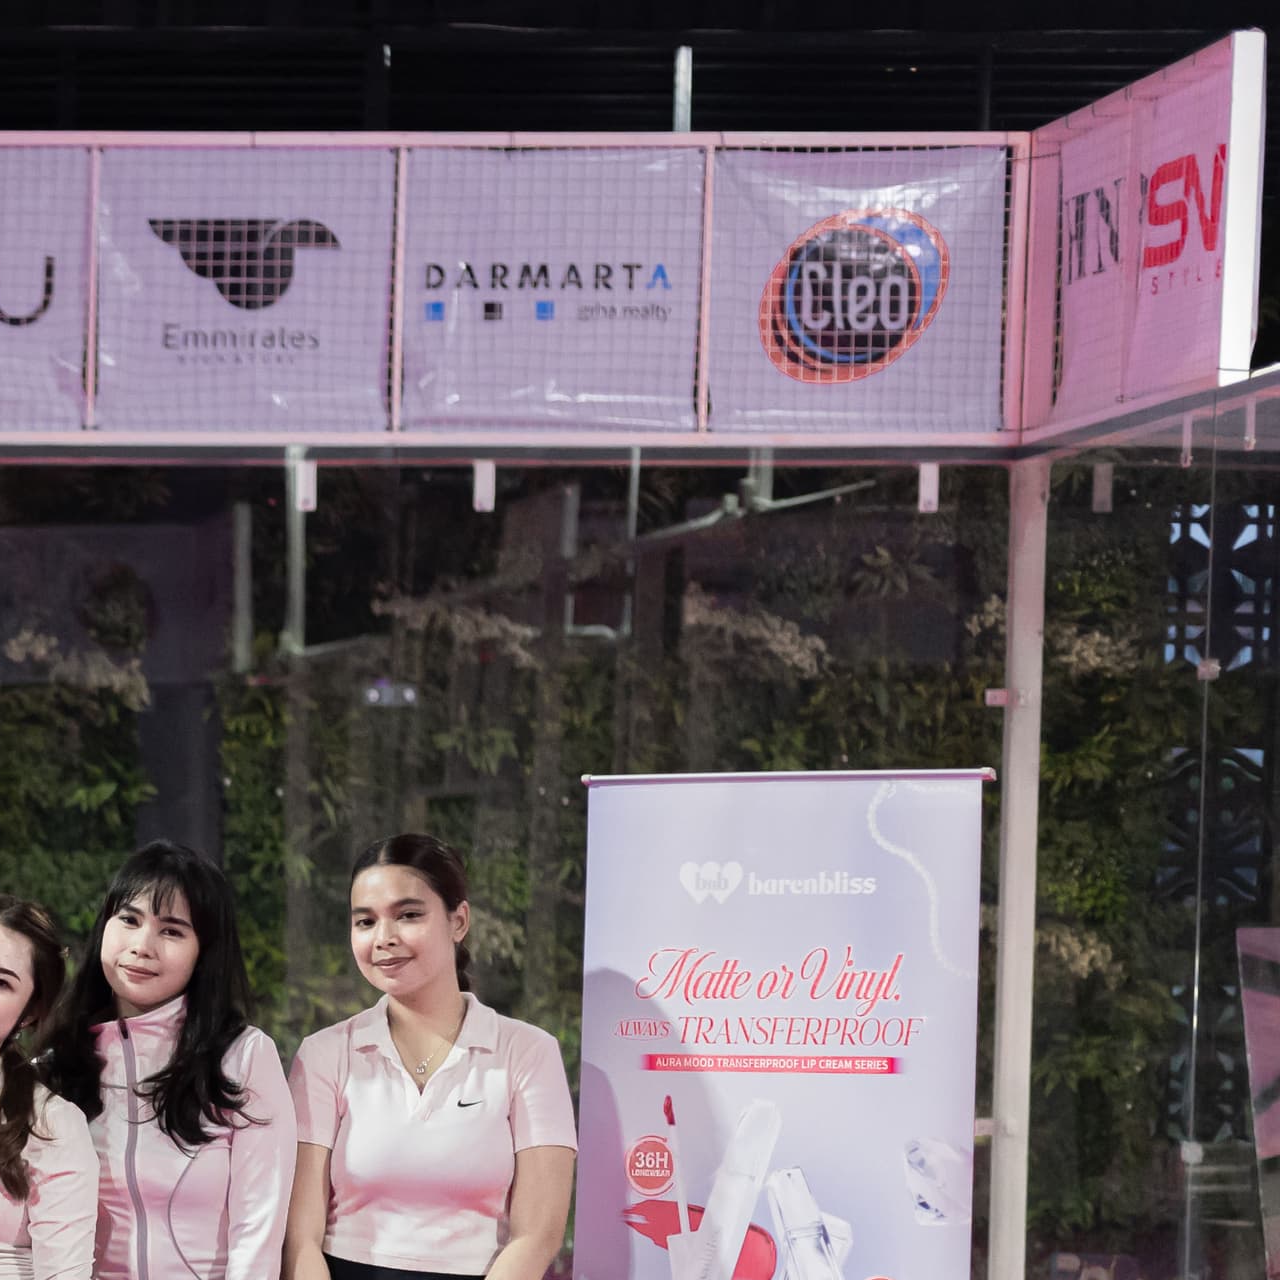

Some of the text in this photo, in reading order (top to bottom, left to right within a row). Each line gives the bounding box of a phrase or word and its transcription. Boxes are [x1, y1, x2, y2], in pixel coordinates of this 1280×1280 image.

[1142, 142, 1228, 271] SN
[424, 262, 673, 290] DARMARTA
[801, 260, 910, 331] Cleo
[748, 871, 878, 896] barenbliss
[635, 945, 905, 1018] Matte or Vinyl.
[614, 1014, 925, 1048] ALWAYS TRANSFERPROOF
[655, 1056, 890, 1072] AURA MOOD TRANSFERPROOF LIP CREAM SERIES
[635, 1151, 669, 1169] 36H
